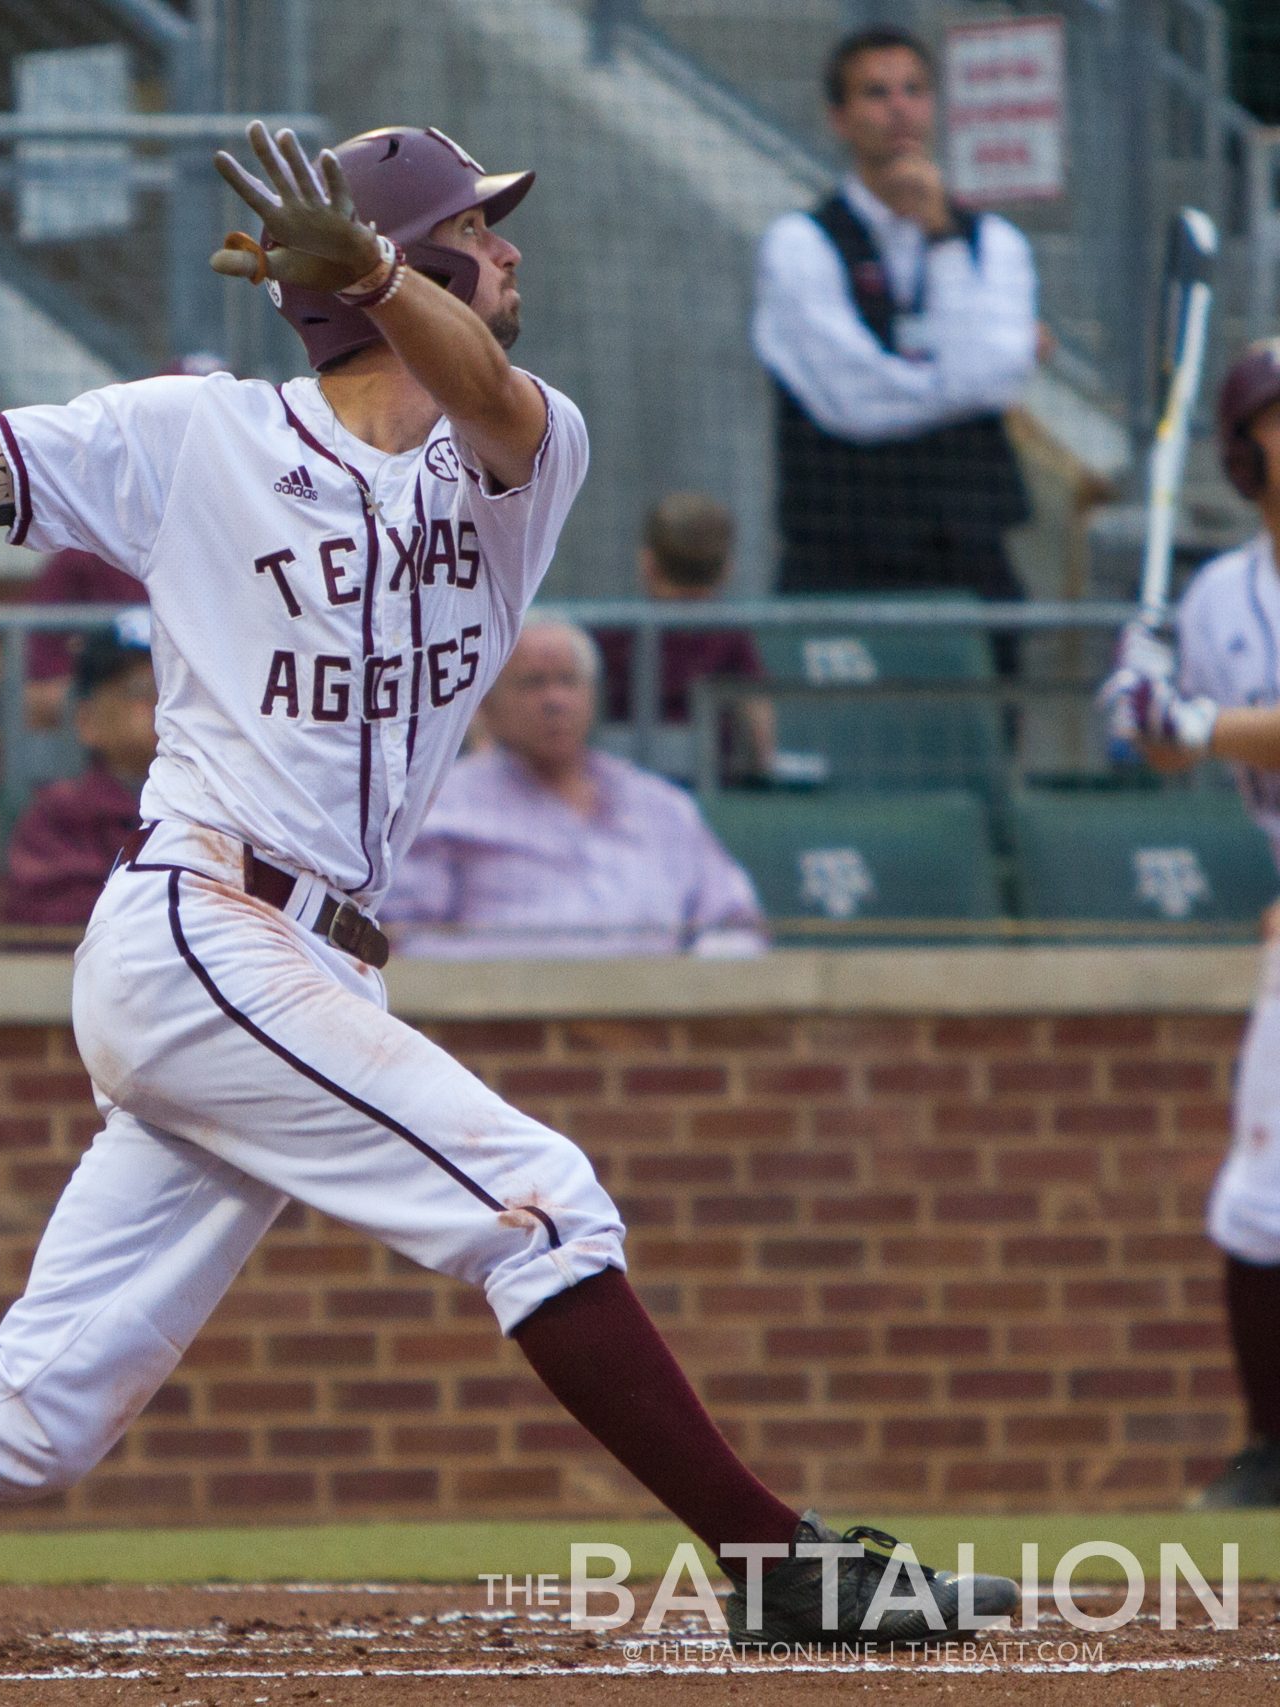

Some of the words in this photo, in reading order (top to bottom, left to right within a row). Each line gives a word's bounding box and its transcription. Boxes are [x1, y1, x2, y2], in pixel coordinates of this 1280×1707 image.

[274, 481, 318, 501] adidas
[253, 519, 480, 619] TEXAS
[260, 623, 482, 722] AGGIES
